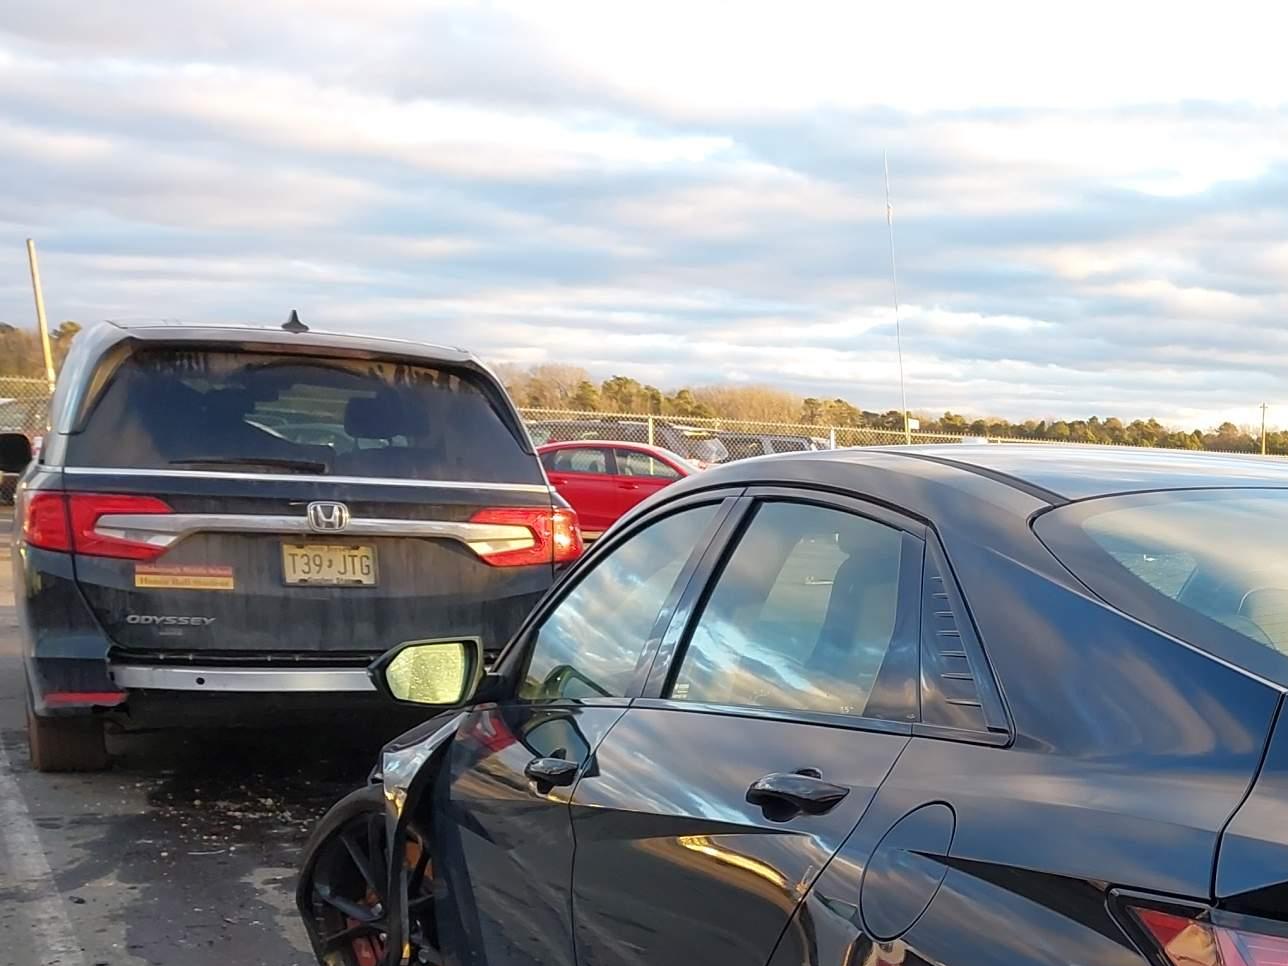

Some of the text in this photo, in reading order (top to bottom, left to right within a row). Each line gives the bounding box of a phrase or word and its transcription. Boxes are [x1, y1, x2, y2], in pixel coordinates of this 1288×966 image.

[288, 552, 371, 576] T39 JTG
[126, 614, 217, 626] ODYSSEY
